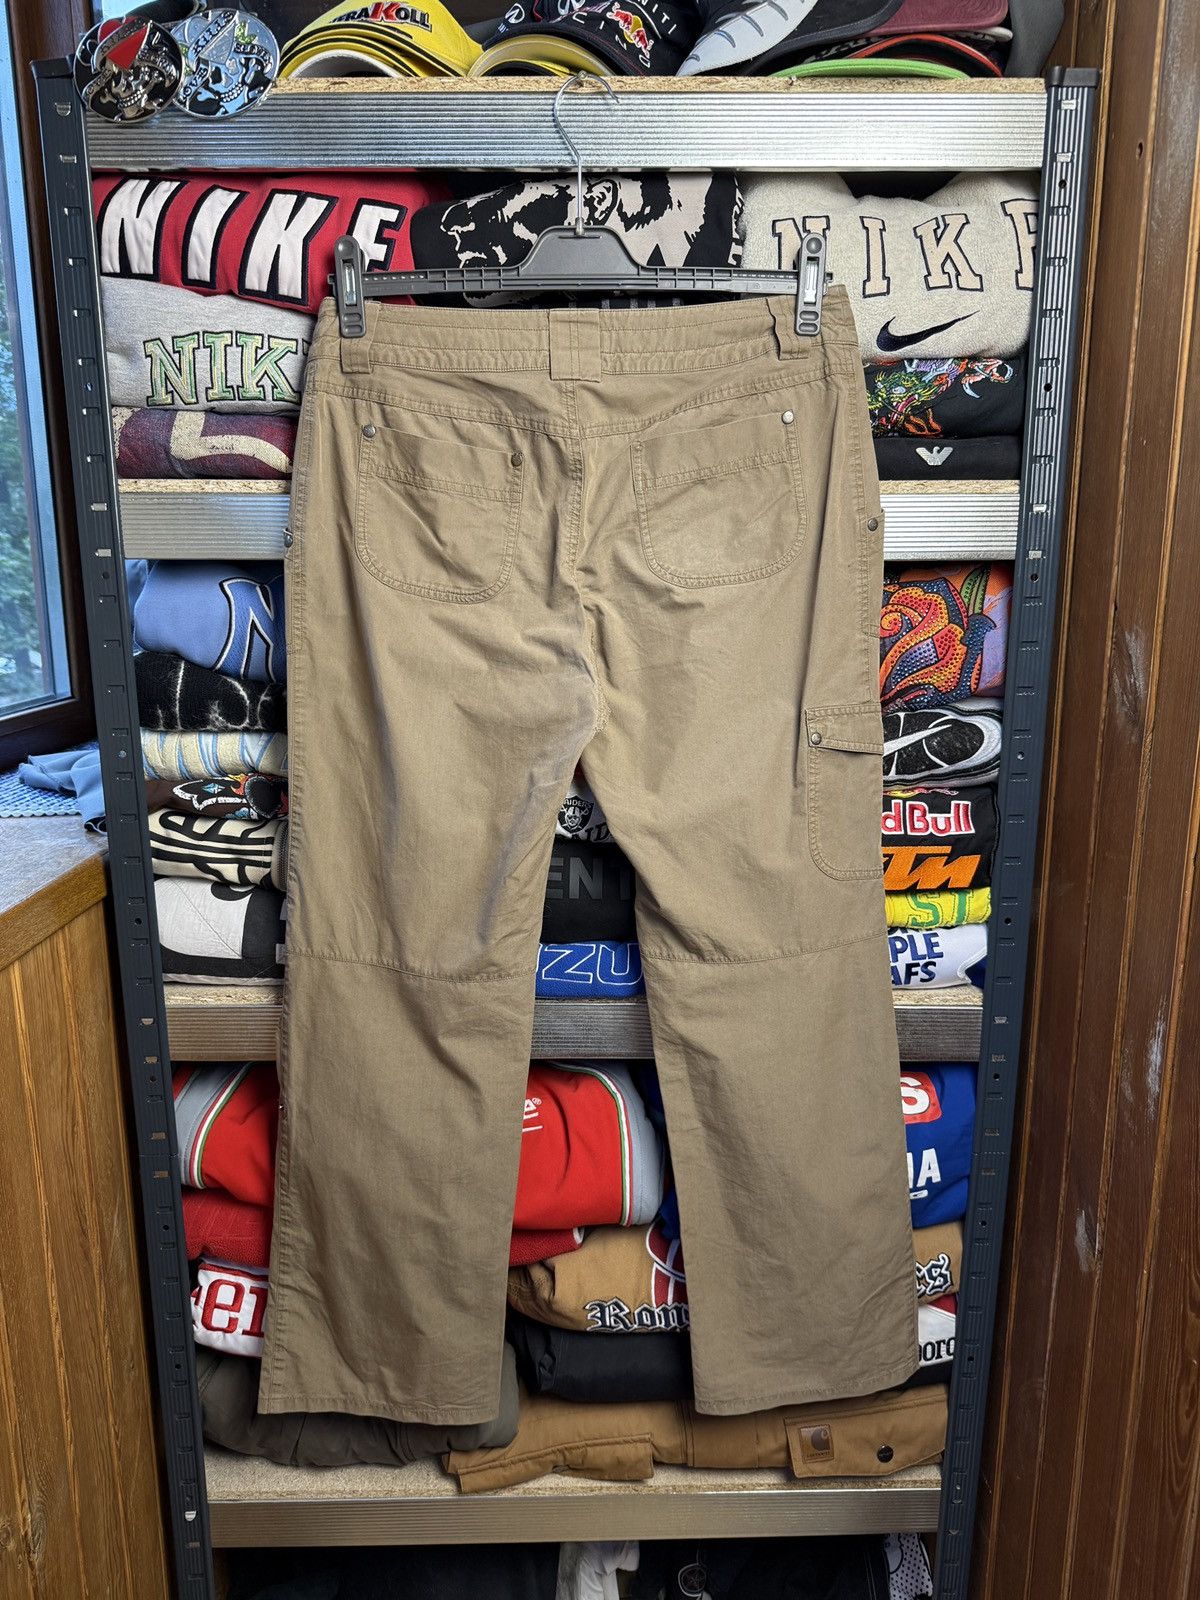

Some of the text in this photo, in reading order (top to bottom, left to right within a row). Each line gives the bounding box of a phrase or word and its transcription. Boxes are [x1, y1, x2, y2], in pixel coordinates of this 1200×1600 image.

[329, 2, 432, 33] ERAKOLL
[97, 176, 407, 306] NIKE
[143, 330, 312, 407] NIK
[907, 801, 975, 836] Bull
[882, 846, 982, 890] TM
[535, 943, 642, 986] ZU
[888, 932, 944, 963] PLE
